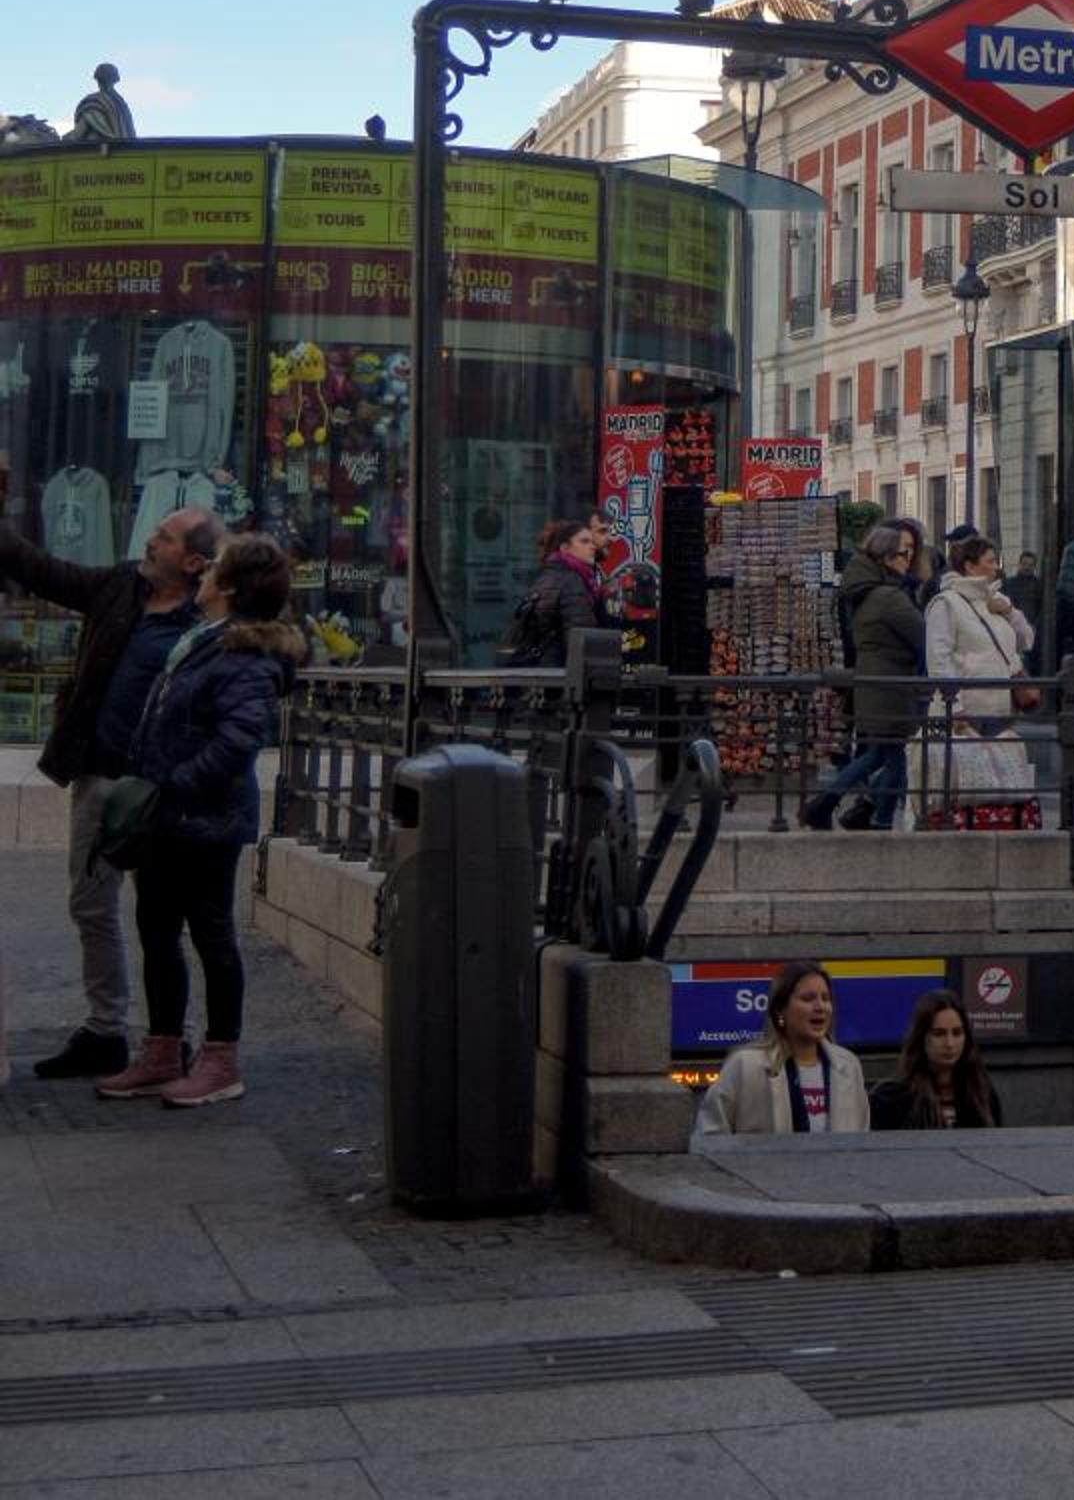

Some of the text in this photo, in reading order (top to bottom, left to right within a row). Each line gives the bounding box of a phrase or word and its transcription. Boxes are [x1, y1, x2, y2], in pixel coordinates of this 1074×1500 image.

[186, 170, 254, 184] SIM CARD
[311, 167, 371, 181] PRENSA
[311, 181, 382, 196] REVISTAS
[533, 187, 590, 205] SIM CARD
[1004, 182, 1059, 209] Sol
[192, 211, 251, 223] TICKETS
[316, 213, 366, 228] TOURS
[540, 227, 589, 243] TICKETS
[86, 260, 162, 278] MADRID
[277, 261, 305, 277] BIG
[351, 263, 385, 280] BIG
[118, 277, 161, 293] HERE
[351, 281, 384, 298] BUY
[468, 287, 512, 305] HERE
[607, 412, 662, 432] MADRID
[747, 445, 822, 463] MADRID
[736, 989, 769, 1012] So
